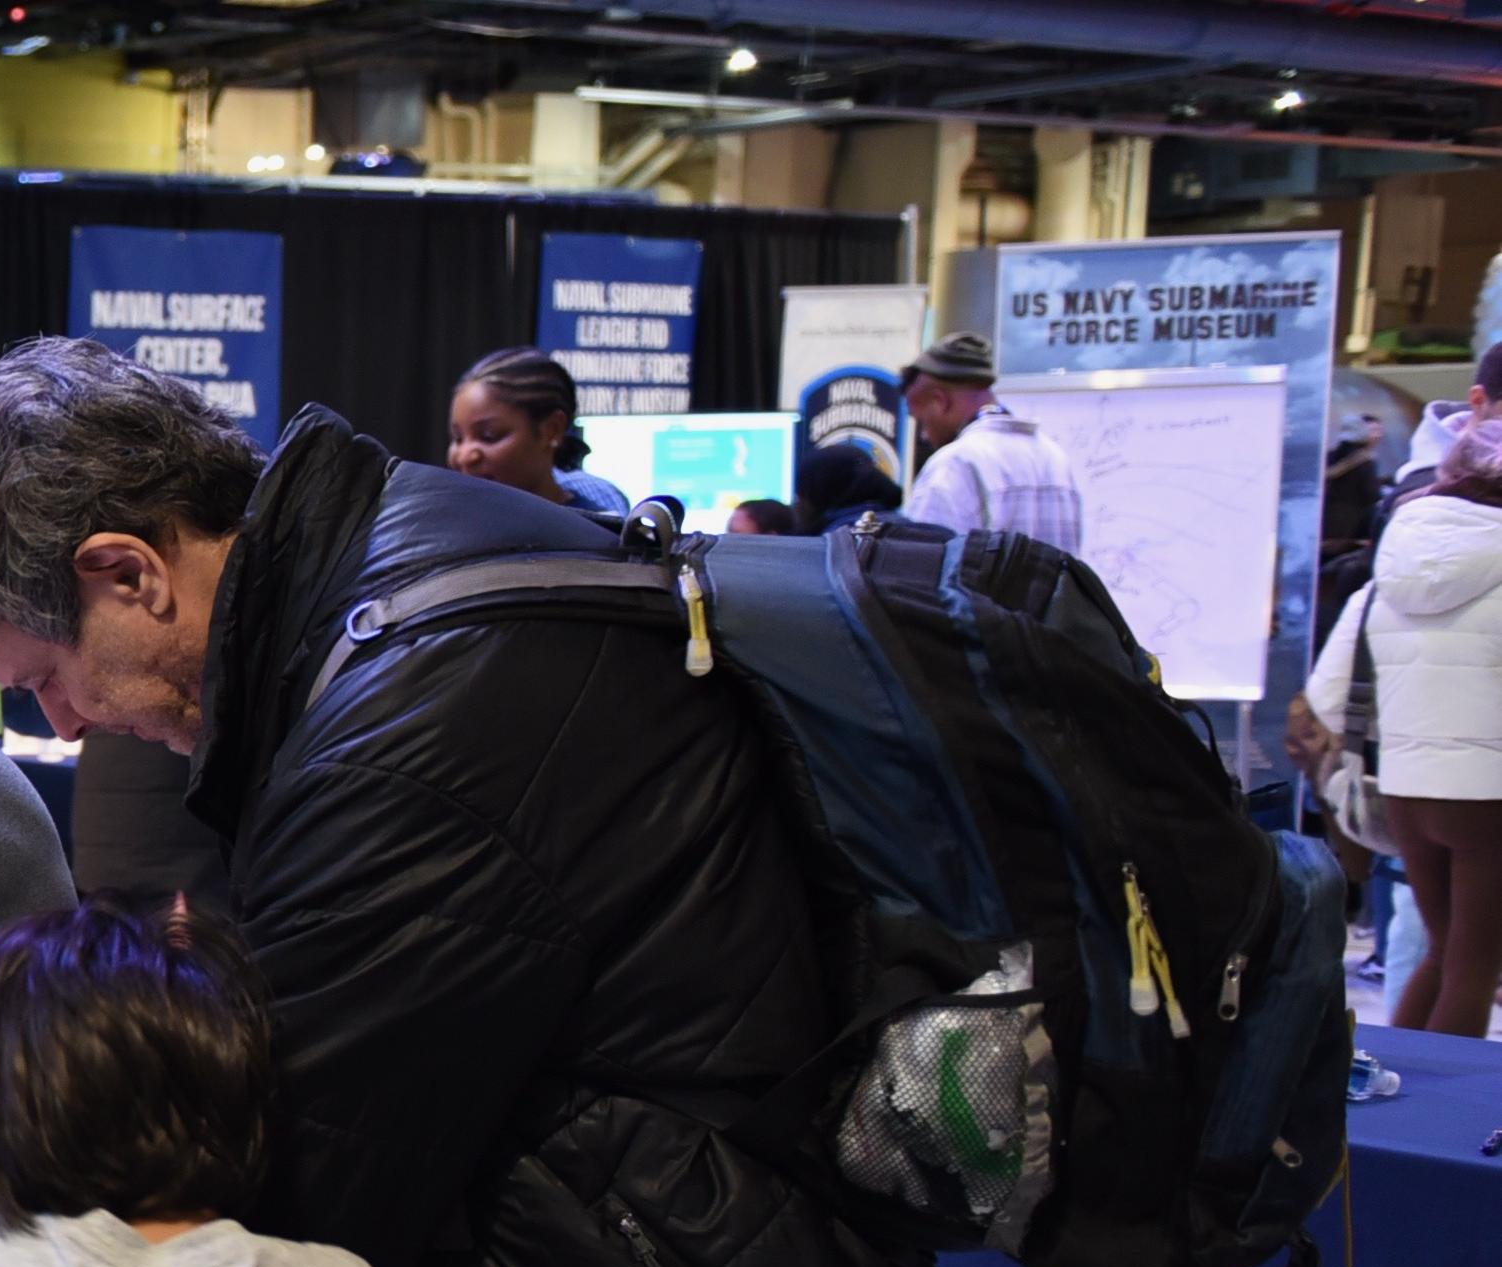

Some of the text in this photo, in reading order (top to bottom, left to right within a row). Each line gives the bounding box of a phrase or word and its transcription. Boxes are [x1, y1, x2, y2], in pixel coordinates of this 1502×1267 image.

[91, 290, 266, 333] NAVAL SURFACE
[553, 279, 693, 316] NAVAL SUBMARINE
[1012, 281, 1318, 318] US NAVY SUBMARINE
[576, 315, 640, 349] LEAGUE
[1048, 312, 1277, 346] FORCE MUSEUM
[134, 335, 230, 377] CENTER,
[828, 376, 877, 405] NAVAL
[809, 402, 895, 443] SUBMARINE
